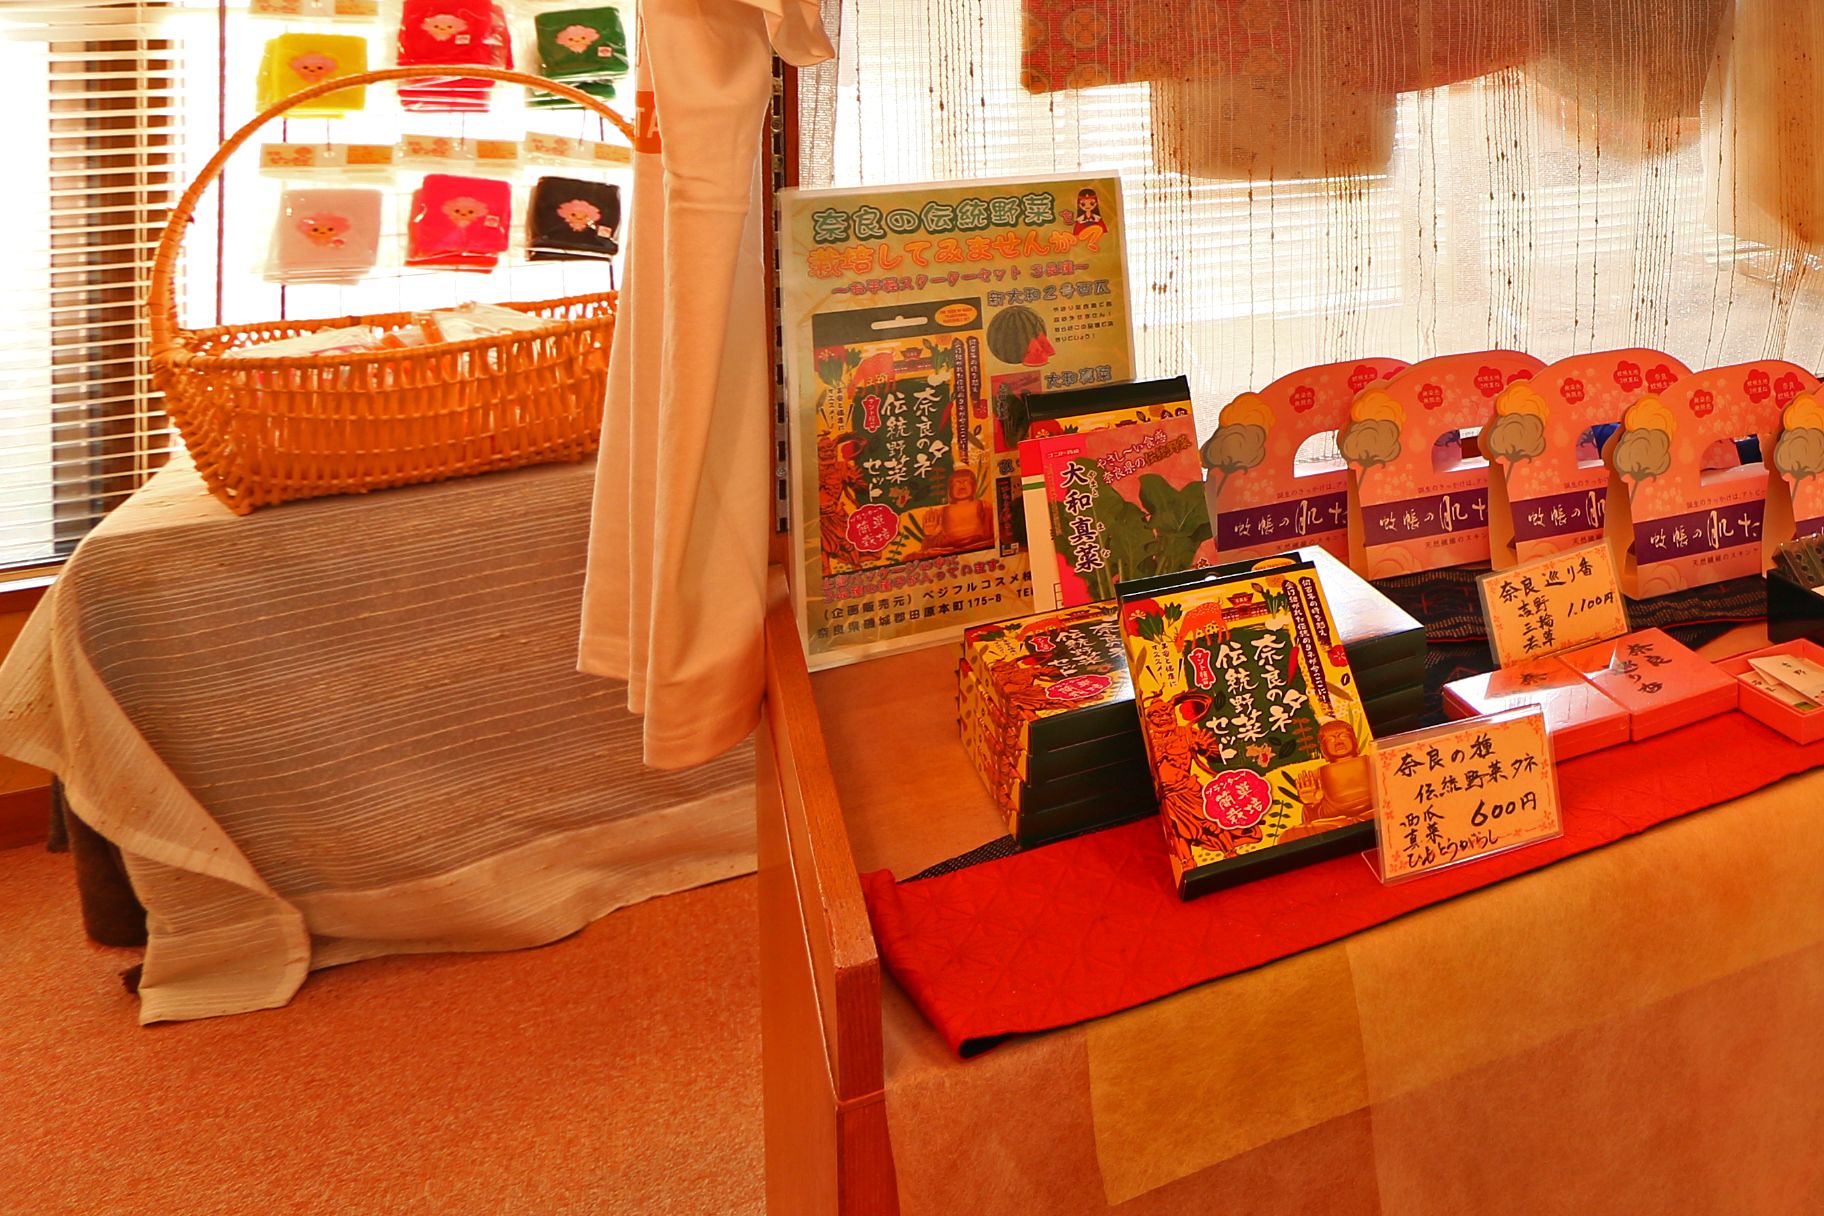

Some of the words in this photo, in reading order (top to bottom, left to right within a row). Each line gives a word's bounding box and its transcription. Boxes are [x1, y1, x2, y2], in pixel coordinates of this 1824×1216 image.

[881, 393, 912, 484] 伝統野菜
[863, 458, 883, 502] セット
[1060, 462, 1104, 573] 大和真菜
[1518, 595, 1550, 618] 吉野
[1216, 641, 1267, 742] 伝統野菜
[1206, 717, 1237, 764] セット
[1394, 733, 1497, 778] 奈良の種
[1414, 753, 1538, 804] 伝統野菜タネ
[1471, 791, 1537, 827] 600円
[1403, 822, 1444, 852] 真菜
